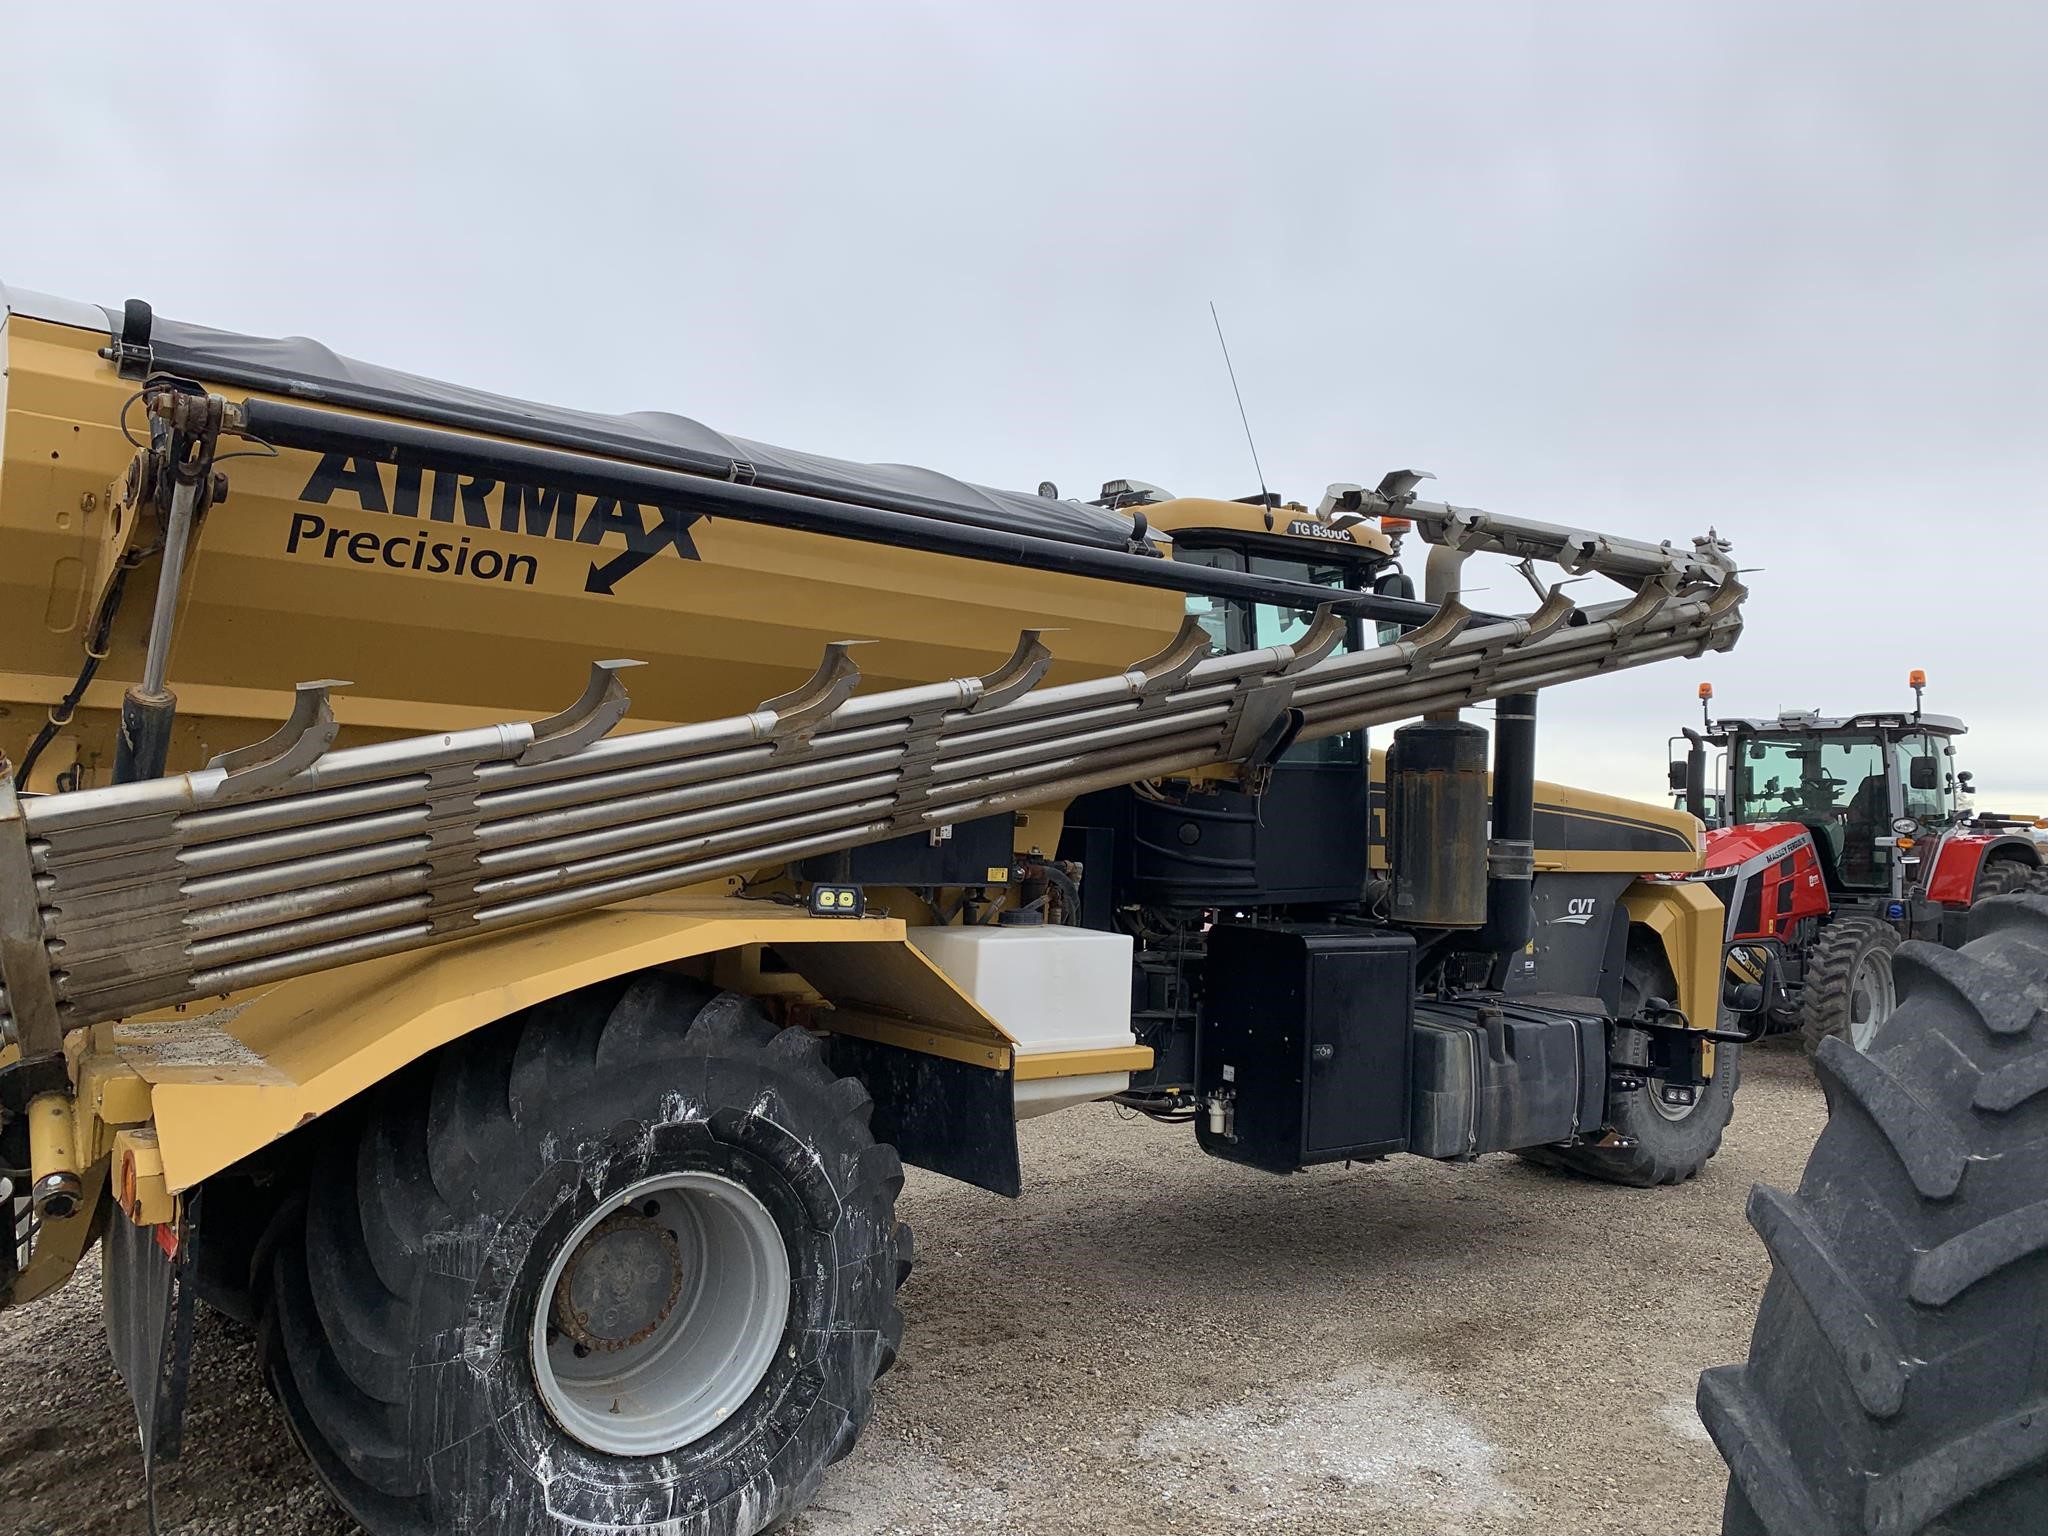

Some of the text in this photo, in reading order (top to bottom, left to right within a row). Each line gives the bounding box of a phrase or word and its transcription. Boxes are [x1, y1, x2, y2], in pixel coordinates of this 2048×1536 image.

[298, 452, 712, 562] AIRMAX
[1292, 520, 1310, 535] TG
[286, 513, 538, 584] Precision
[1766, 846, 1788, 863] MASSEY
[1568, 898, 1595, 914] CVT
